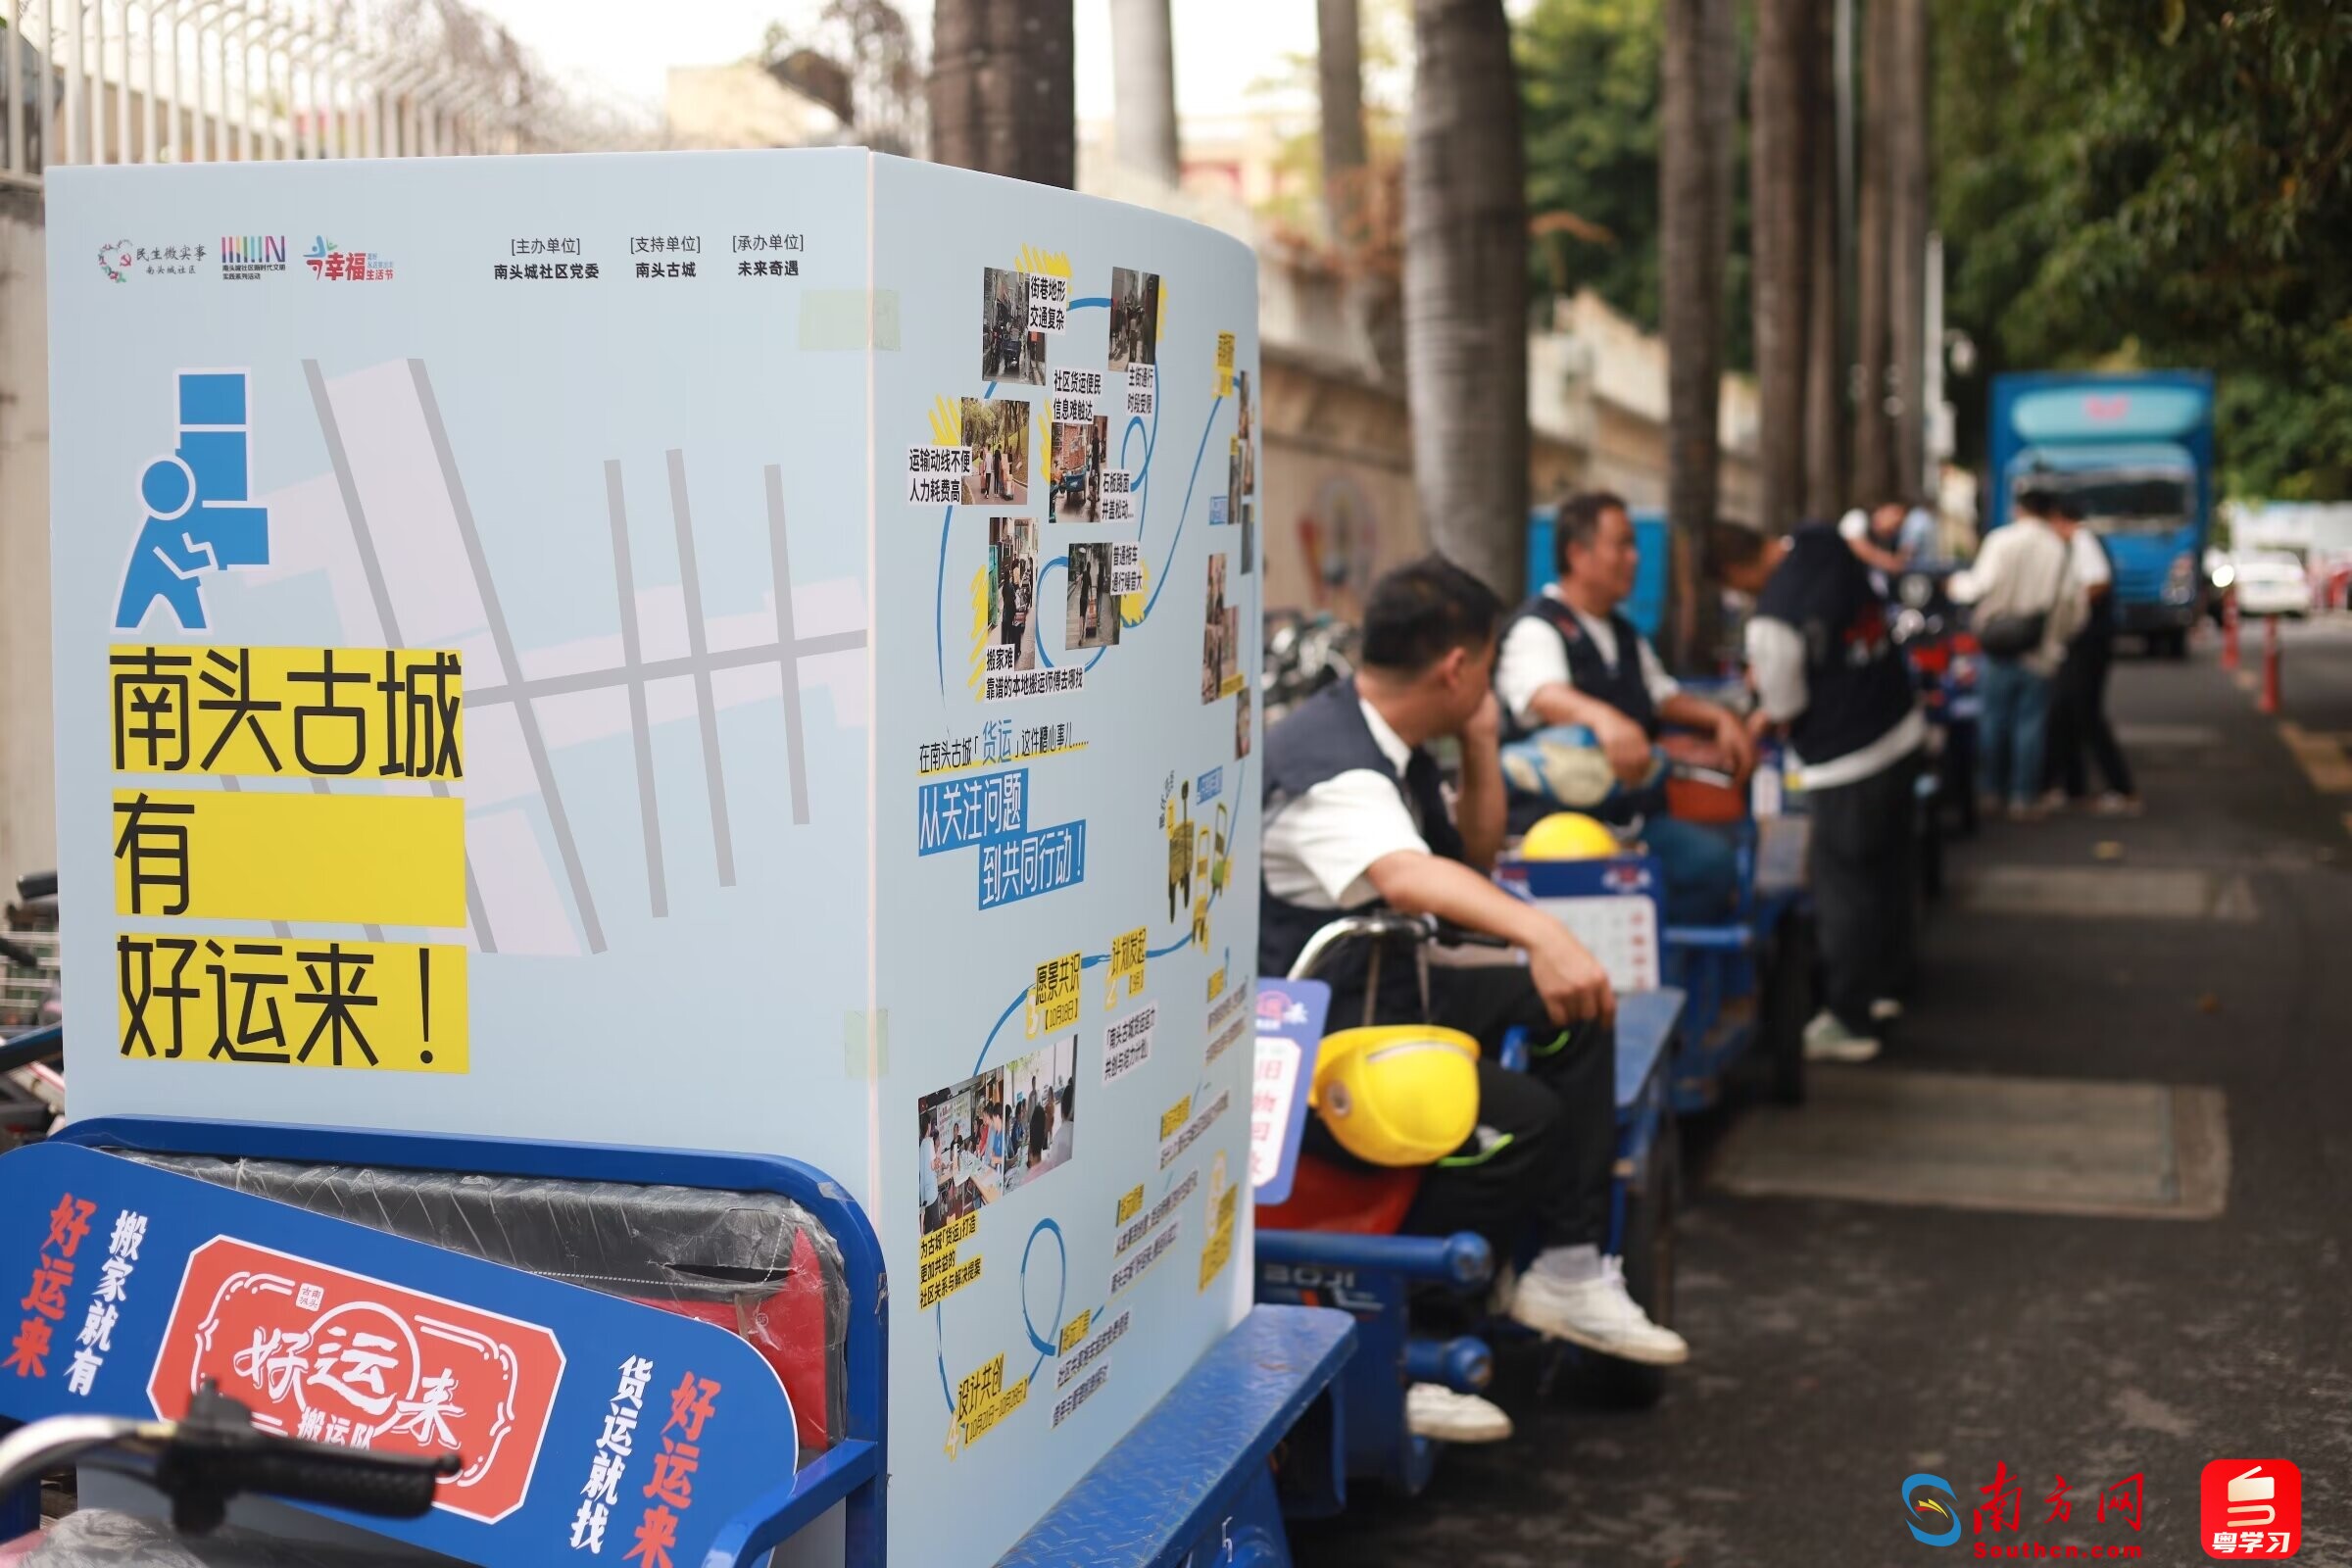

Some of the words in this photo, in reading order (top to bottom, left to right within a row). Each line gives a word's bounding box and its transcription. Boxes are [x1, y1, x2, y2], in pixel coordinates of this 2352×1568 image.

[136, 244, 206, 263] 民生微实事
[511, 238, 581, 256] [主办单位]
[630, 236, 701, 254] [支持单位]
[732, 234, 804, 253] [承办单位]
[325, 252, 366, 280] 幸福
[366, 270, 394, 280] 生活节
[494, 263, 600, 280] 南头城社区党委
[635, 262, 697, 279] 南头古城
[738, 260, 800, 277] 未来奇遇
[1030, 275, 1066, 303] 街巷地形
[1030, 307, 1065, 330] 交通复杂
[1054, 369, 1102, 396] 社区货运便民
[1129, 367, 1153, 388] 主街通行
[1054, 398, 1094, 421] 信息难触达
[1128, 393, 1152, 414] 时段受限
[909, 448, 971, 474] 运输动线不便
[909, 479, 960, 504] 人力耗费高
[1103, 472, 1129, 493] 石板路面
[1113, 545, 1138, 565] 普通拖车
[1112, 570, 1143, 592] 通行噪音大
[987, 648, 1013, 671] 搬家难
[986, 667, 1083, 700] 靠谱的本地搬运师傅去哪找
[110, 647, 463, 778] 南头古城
[920, 772, 1021, 850] 从关注问题
[114, 792, 194, 915] 有
[983, 825, 1082, 905] 到共同行动！
[1111, 928, 1146, 976] 计划发起
[1036, 954, 1080, 1005] 愿景共识
[118, 935, 433, 1066] 好运来！
[920, 1249, 956, 1285] 更加共益的
[2, 1192, 97, 1378] 好运来
[920, 1258, 982, 1309] 社区关系与解决提案
[65, 1208, 148, 1397] 搬家就有
[233, 1326, 466, 1450] 好运来
[957, 1353, 1004, 1422] 设计共创
[297, 1406, 376, 1451] 搬运队
[569, 1353, 654, 1554] 货运就找
[625, 1371, 721, 1568] 好运来
